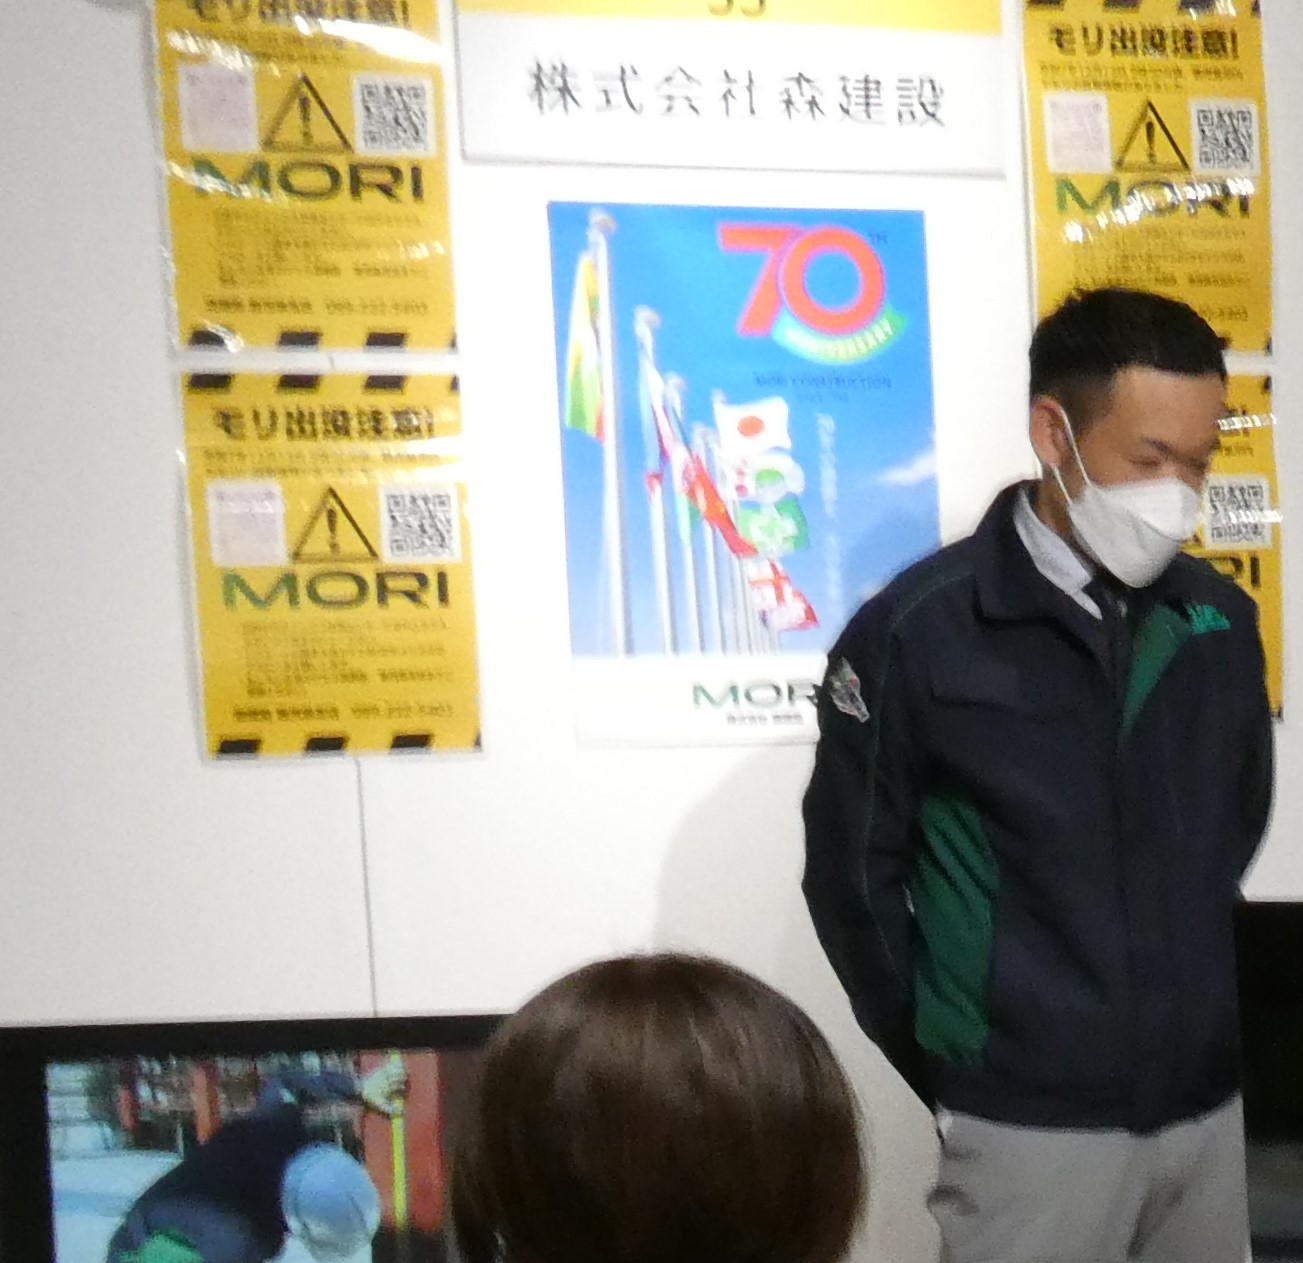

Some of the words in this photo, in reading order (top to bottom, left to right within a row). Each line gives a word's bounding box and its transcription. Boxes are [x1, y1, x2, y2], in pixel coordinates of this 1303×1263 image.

[527, 56, 946, 128] 株式会社森建設
[191, 160, 425, 203] MORI
[1054, 176, 1252, 218] MORI
[717, 221, 887, 338] 70
[221, 570, 451, 609] MORI
[692, 679, 820, 709] MOR
